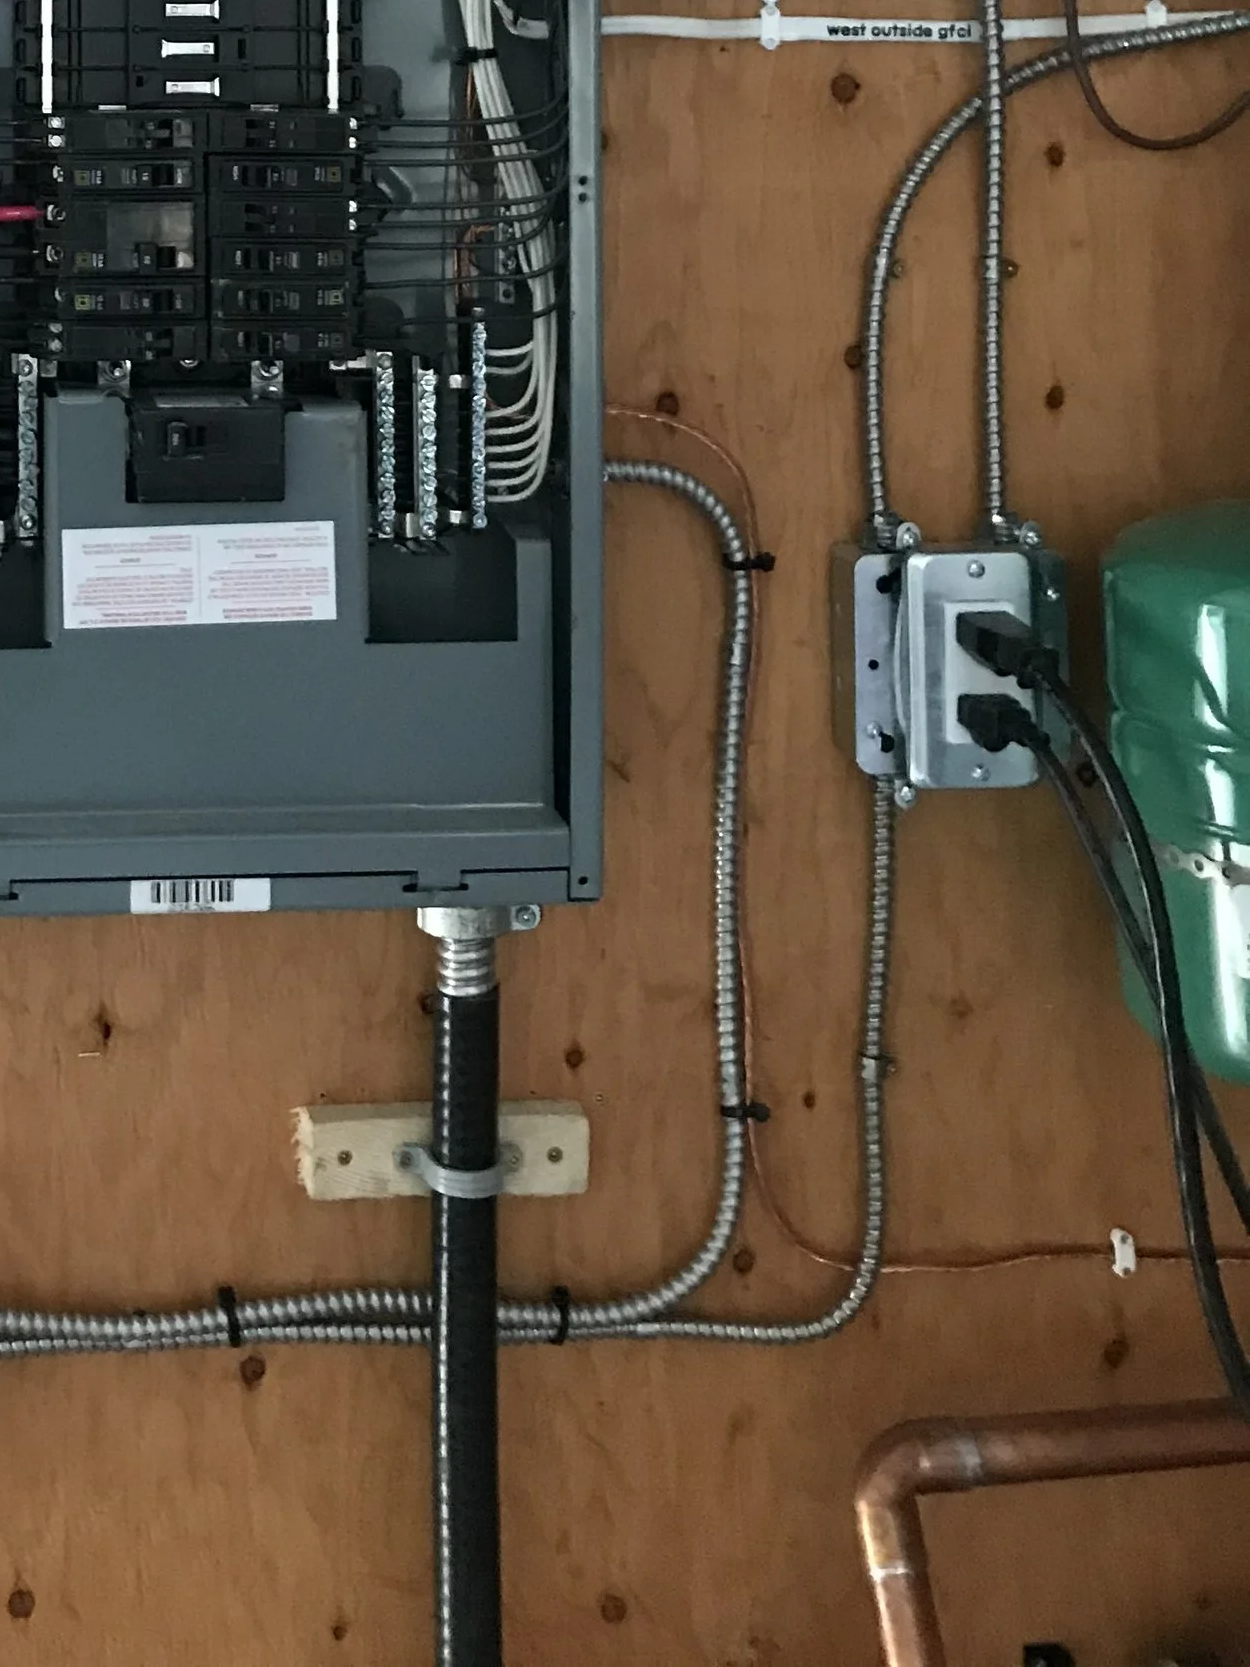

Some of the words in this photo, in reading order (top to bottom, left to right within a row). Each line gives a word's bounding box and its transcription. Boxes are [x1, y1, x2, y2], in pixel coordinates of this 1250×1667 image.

[827, 24, 866, 36] west
[872, 24, 932, 37] outside
[939, 24, 971, 39] gfci
